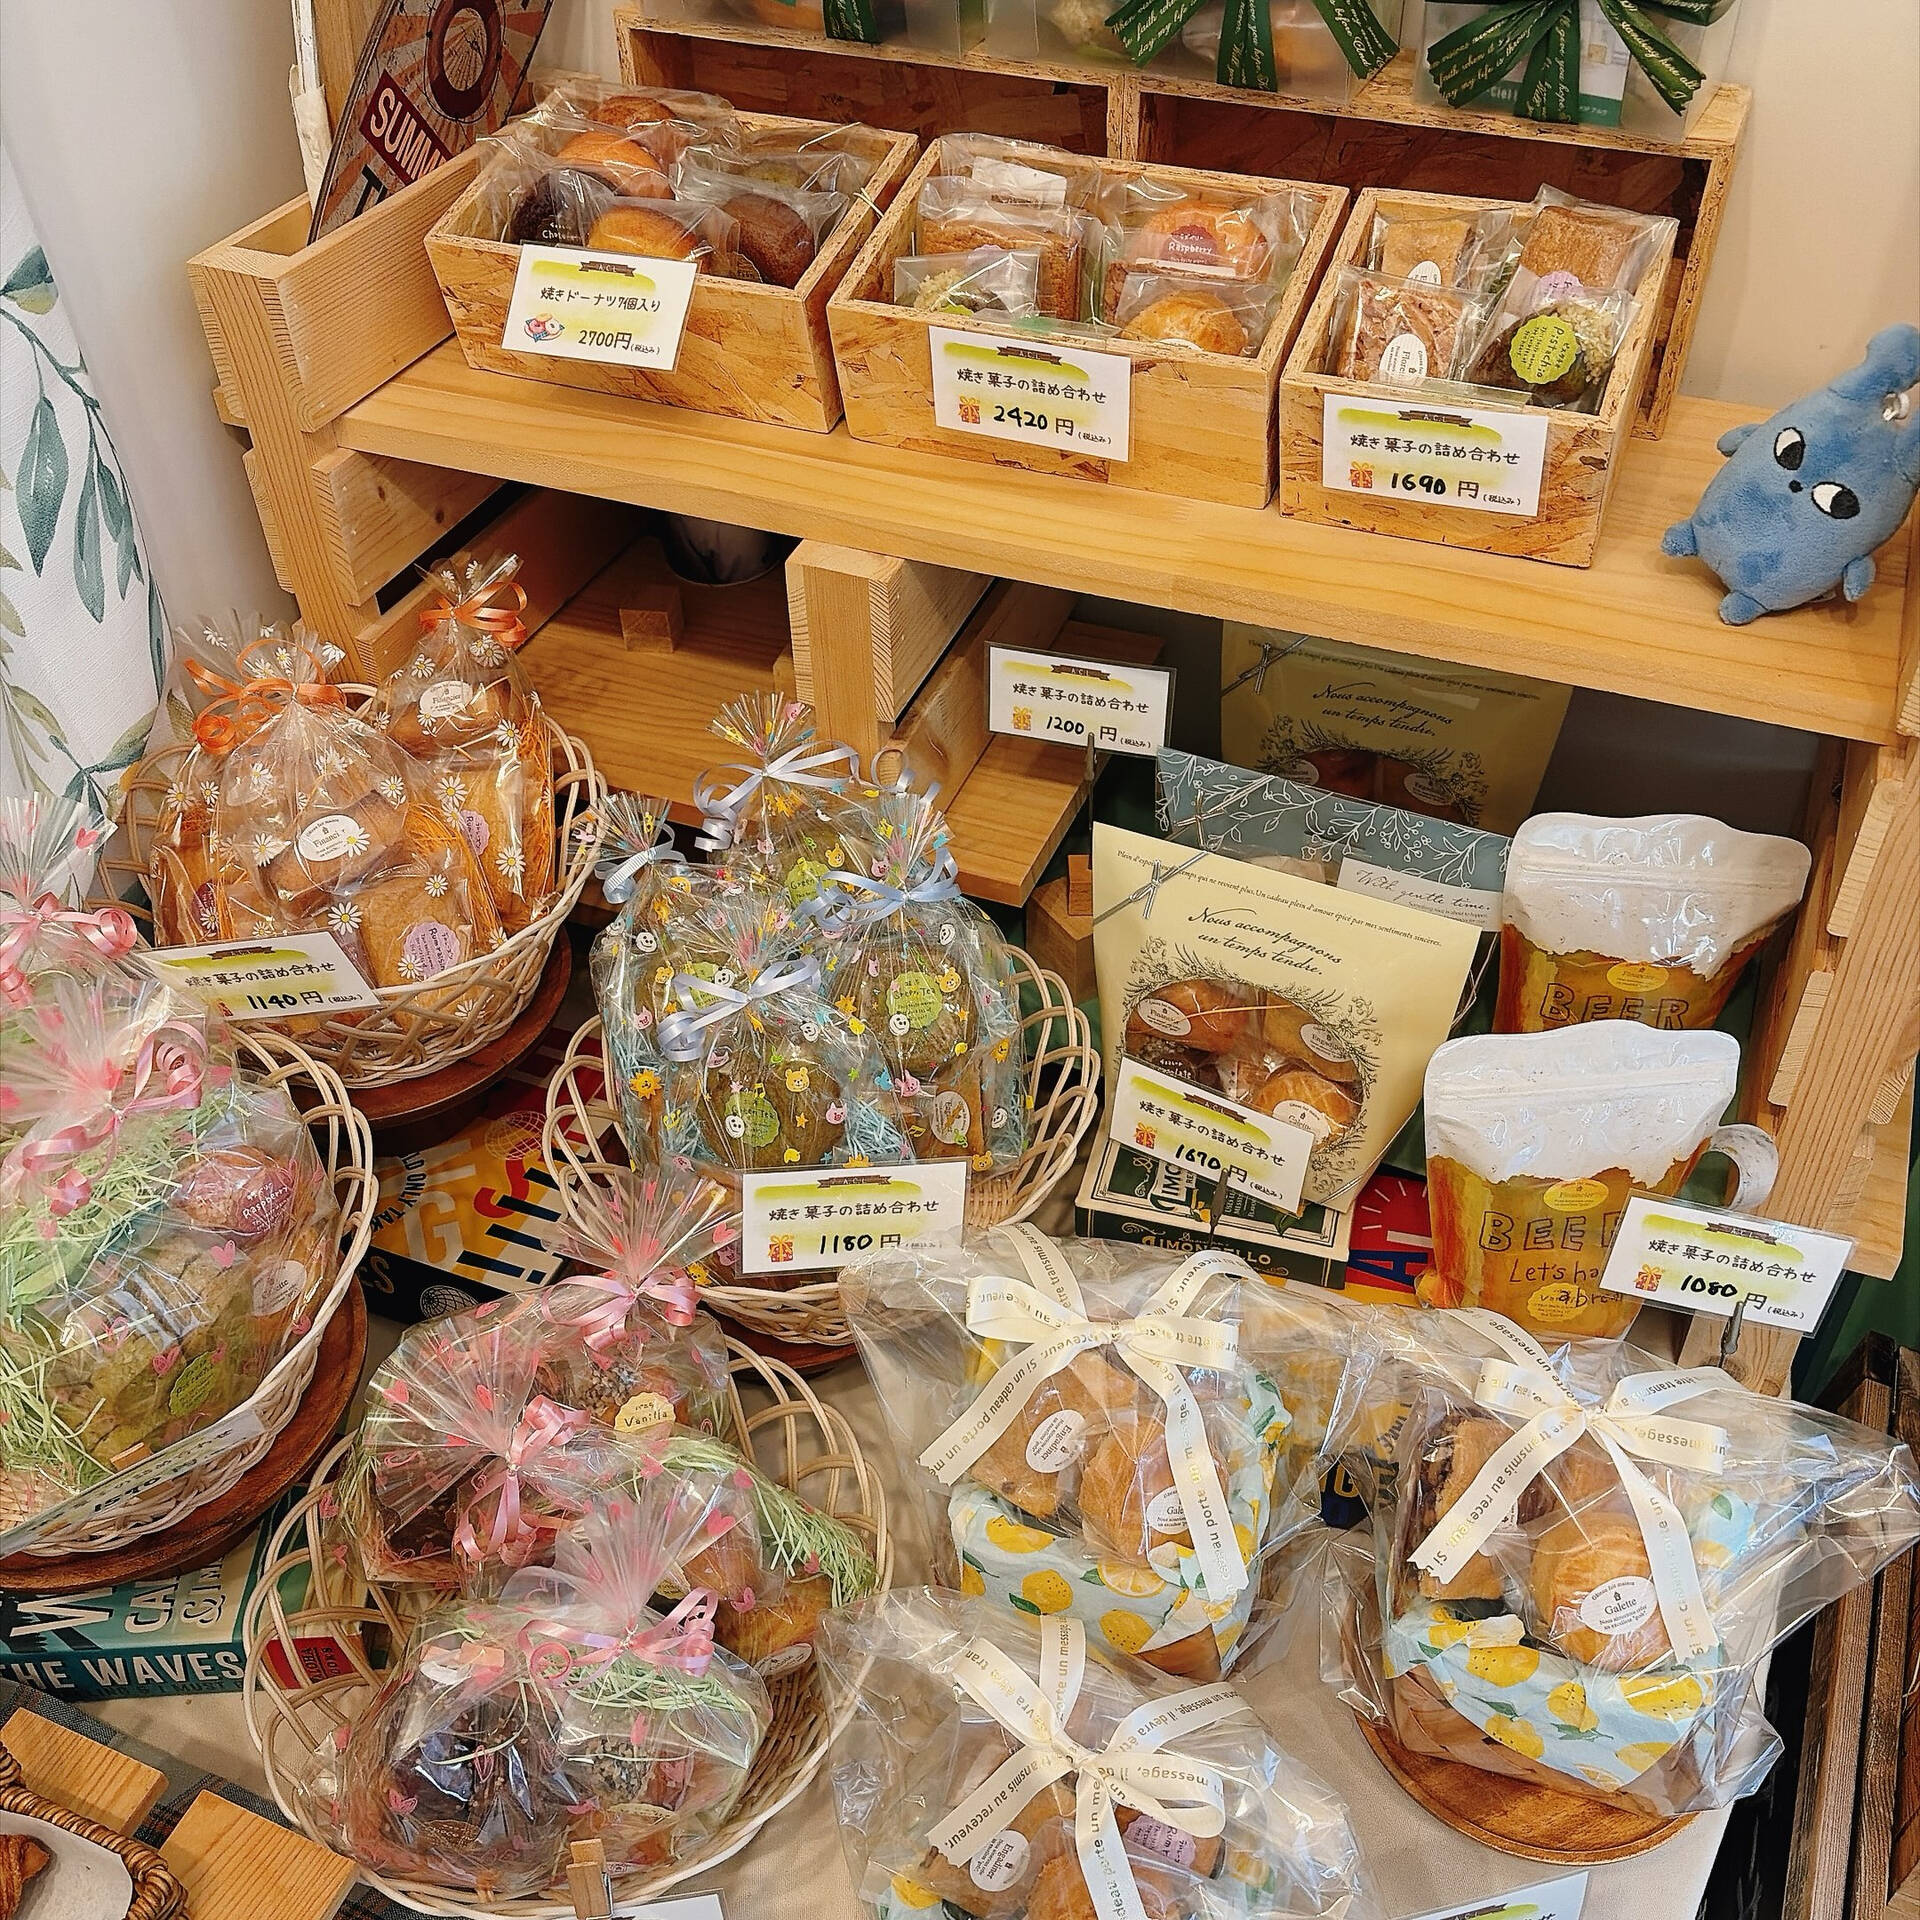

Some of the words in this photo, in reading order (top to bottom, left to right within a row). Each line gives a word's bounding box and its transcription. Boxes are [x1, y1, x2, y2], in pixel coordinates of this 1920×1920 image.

[1168, 241, 1213, 256] Raspberry
[540, 286, 661, 314] 焼きドーナツ7個入り
[956, 367, 1107, 405] 焼き菓子の詰め合わせ
[993, 405, 1049, 431] 2420
[1055, 416, 1075, 437] 円
[1349, 433, 1521, 466] 焼き菓子の詰め合わせ
[1391, 472, 1446, 496] 1690
[1457, 480, 1480, 500] 円
[1012, 682, 1150, 715] 焼き菓子の詰め合わせ
[1046, 715, 1085, 735] 1200
[1099, 725, 1118, 743] 円
[1197, 931, 1217, 946] un
[1217, 934, 1268, 960] temps
[1270, 948, 1325, 977] tendre.
[1233, 919, 1344, 965] accompagnons
[246, 993, 298, 1010] 1140
[300, 990, 325, 1005] 円
[1138, 1100, 1287, 1167] 焼き菓子の詰め合わせ
[1229, 1163, 1248, 1183] 円
[768, 1200, 940, 1222] 焼き菓子の詰め合わせ
[819, 1234, 874, 1254] 1180
[1033, 1244, 1061, 1286] transmis
[1509, 1258, 1567, 1284] Let's
[1648, 1239, 1817, 1284] 焼き菓子の詰め合わせ
[1680, 1274, 1738, 1298] 1080
[1744, 1291, 1768, 1311] 円
[1013, 1369, 1026, 1383] un
[1026, 1358, 1038, 1374] Si
[990, 1381, 1015, 1416] cadeau
[961, 1412, 991, 1445] porte
[945, 1443, 962, 1460] un
[1491, 1476, 1507, 1494] au
[1604, 1597, 1638, 1616] Galette
[81, 1651, 245, 1687] WAVES
[1174, 1696, 1213, 1716] message,
[1137, 1714, 1169, 1737] devra
[993, 1792, 1009, 1807] au
[943, 1806, 995, 1850] receveur.
